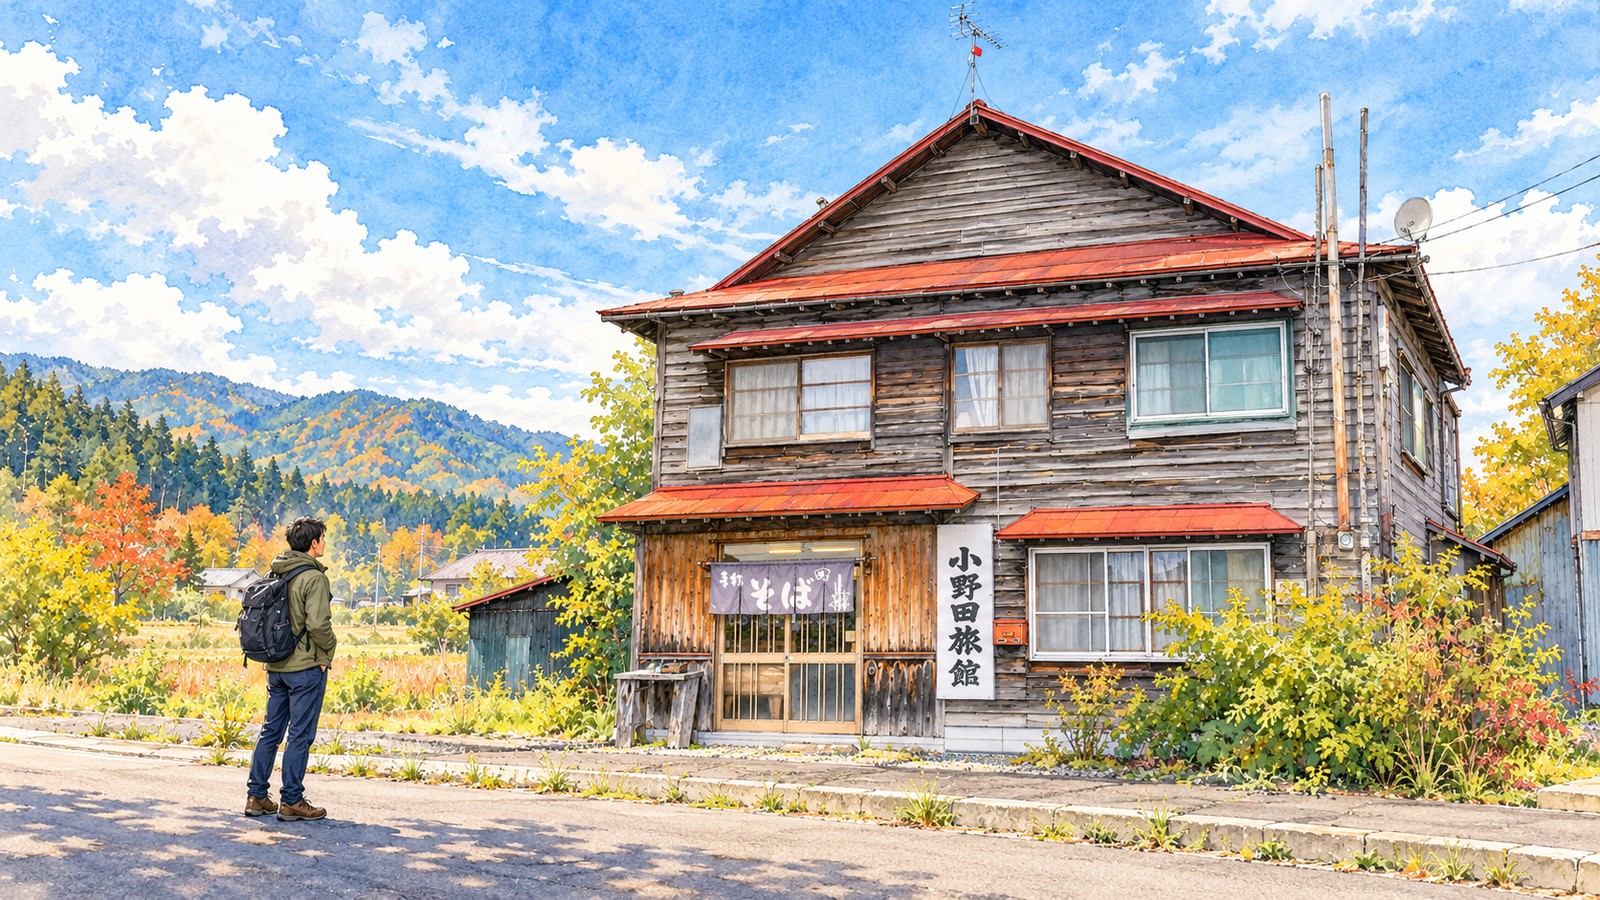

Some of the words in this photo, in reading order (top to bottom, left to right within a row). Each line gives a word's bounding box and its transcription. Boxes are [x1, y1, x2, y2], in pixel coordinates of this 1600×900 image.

[750, 577, 815, 611] そば
[948, 546, 983, 688] 小野田旅館
